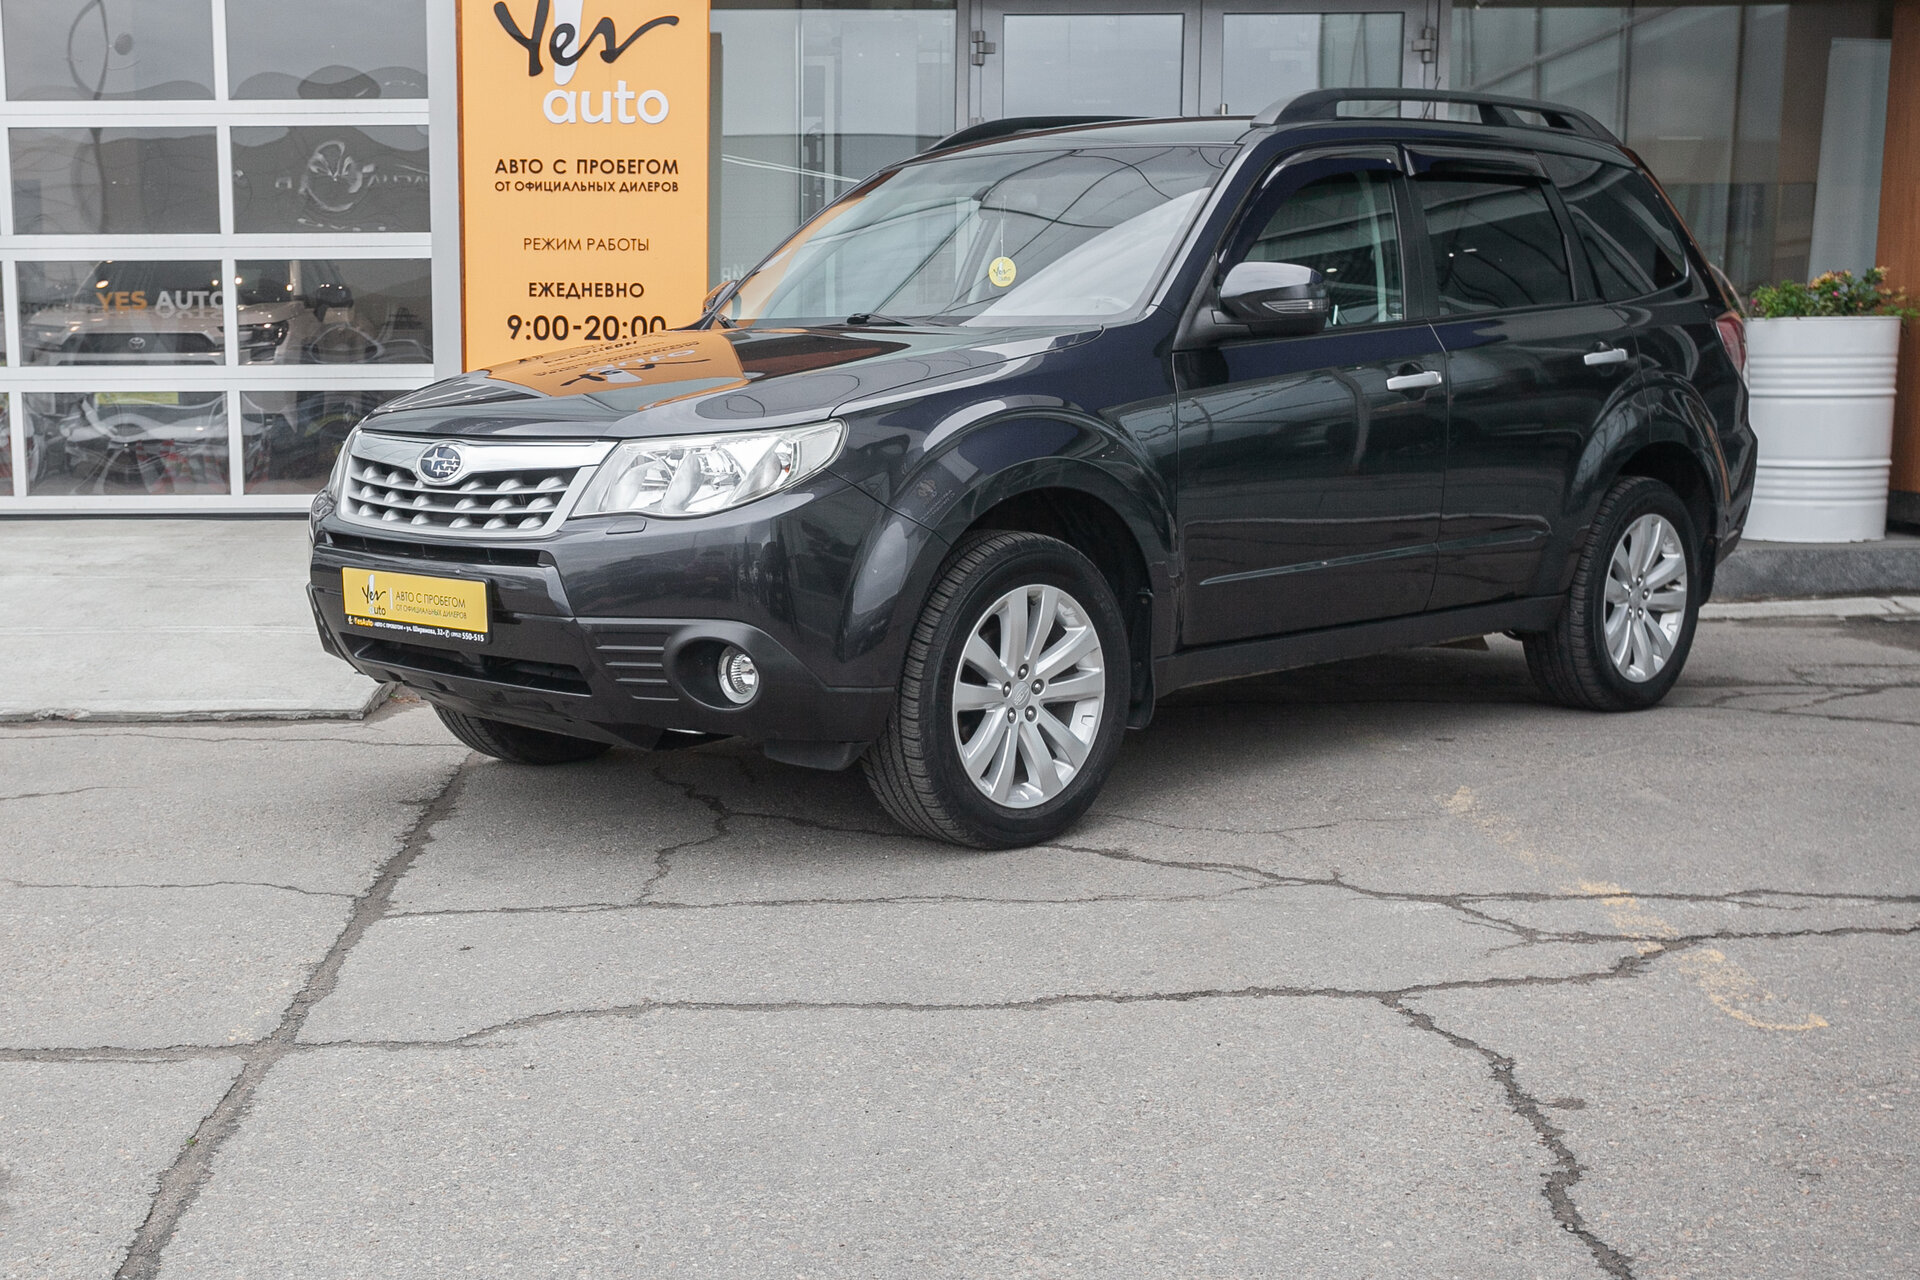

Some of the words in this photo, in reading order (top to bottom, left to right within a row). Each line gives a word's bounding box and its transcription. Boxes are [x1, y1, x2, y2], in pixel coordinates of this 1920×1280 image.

[542, 80, 670, 124] auto
[494, 158, 543, 174] АВТО
[552, 158, 567, 174] С
[576, 158, 679, 175] ПРОБЕГОМ
[494, 181, 511, 192] ОТ
[514, 181, 616, 193] ОФИЦИАЛЬНЫХ
[619, 181, 679, 193] ДИЛЕРОВ
[523, 238, 581, 250] РЕЖИМ
[587, 238, 649, 251] РАБОТЫ
[529, 282, 645, 299] ЕЖЕДНЕВНО
[96, 291, 148, 311] YES
[507, 315, 667, 341] 9:00-20:00
[395, 591, 415, 603] АВТО
[416, 592, 422, 604] С
[423, 593, 466, 609] ПРОБЕГОМ
